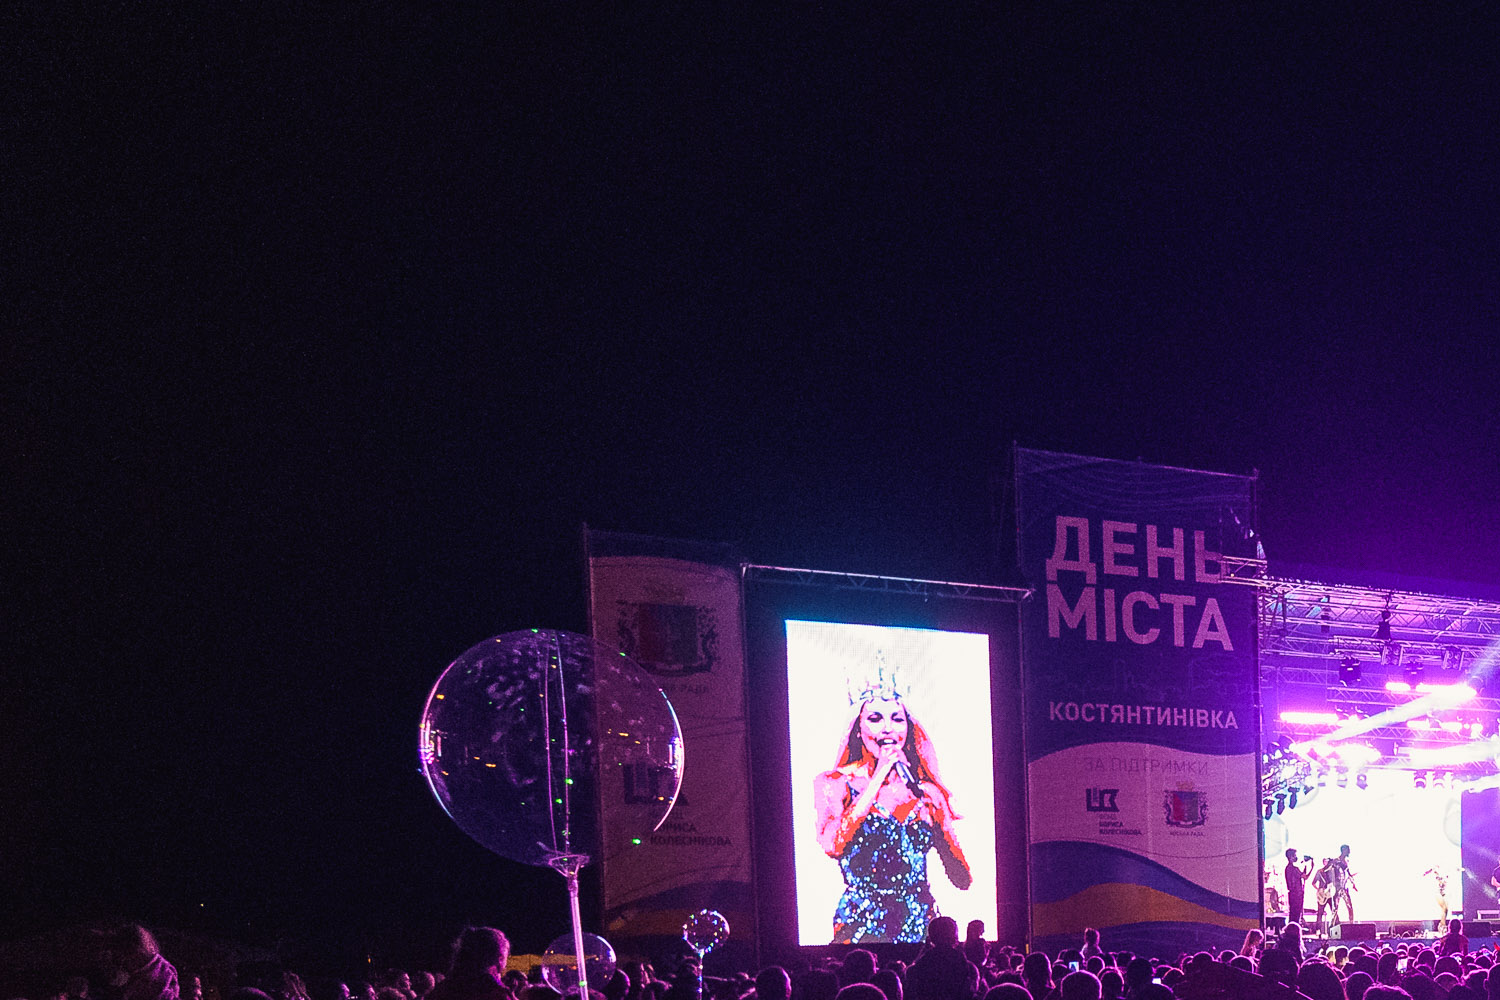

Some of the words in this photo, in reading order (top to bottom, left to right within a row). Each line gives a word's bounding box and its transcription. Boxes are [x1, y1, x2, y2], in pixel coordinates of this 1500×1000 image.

[1046, 515, 1230, 584] ДЕНЬ
[1046, 583, 1234, 651] МІСТА
[1050, 701, 1239, 730] КОСТЯНТИНІВКА
[1084, 757, 1105, 772] ЗА
